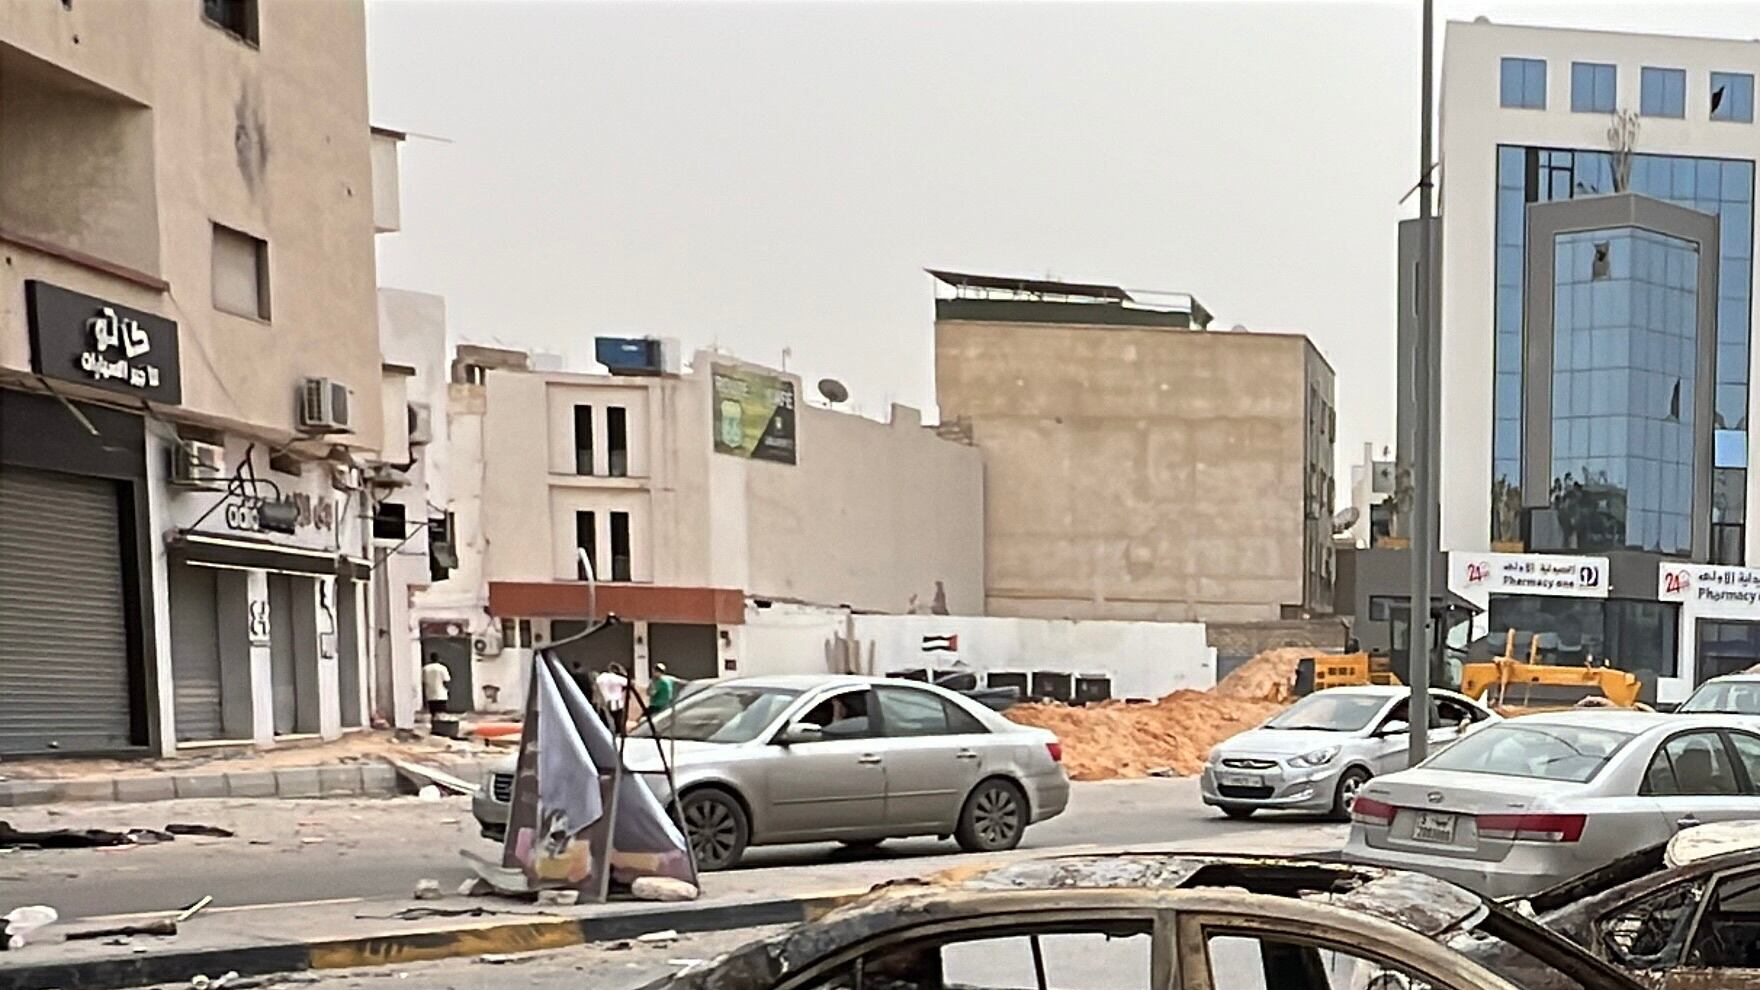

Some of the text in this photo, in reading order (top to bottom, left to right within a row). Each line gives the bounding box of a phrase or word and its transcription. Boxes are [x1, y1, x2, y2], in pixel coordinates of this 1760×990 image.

[1467, 564, 1485, 583] 24
[1665, 572, 1681, 593] 24
[1503, 576, 1575, 590] Pharmacy one
[1698, 587, 1757, 605] Pharmacy
